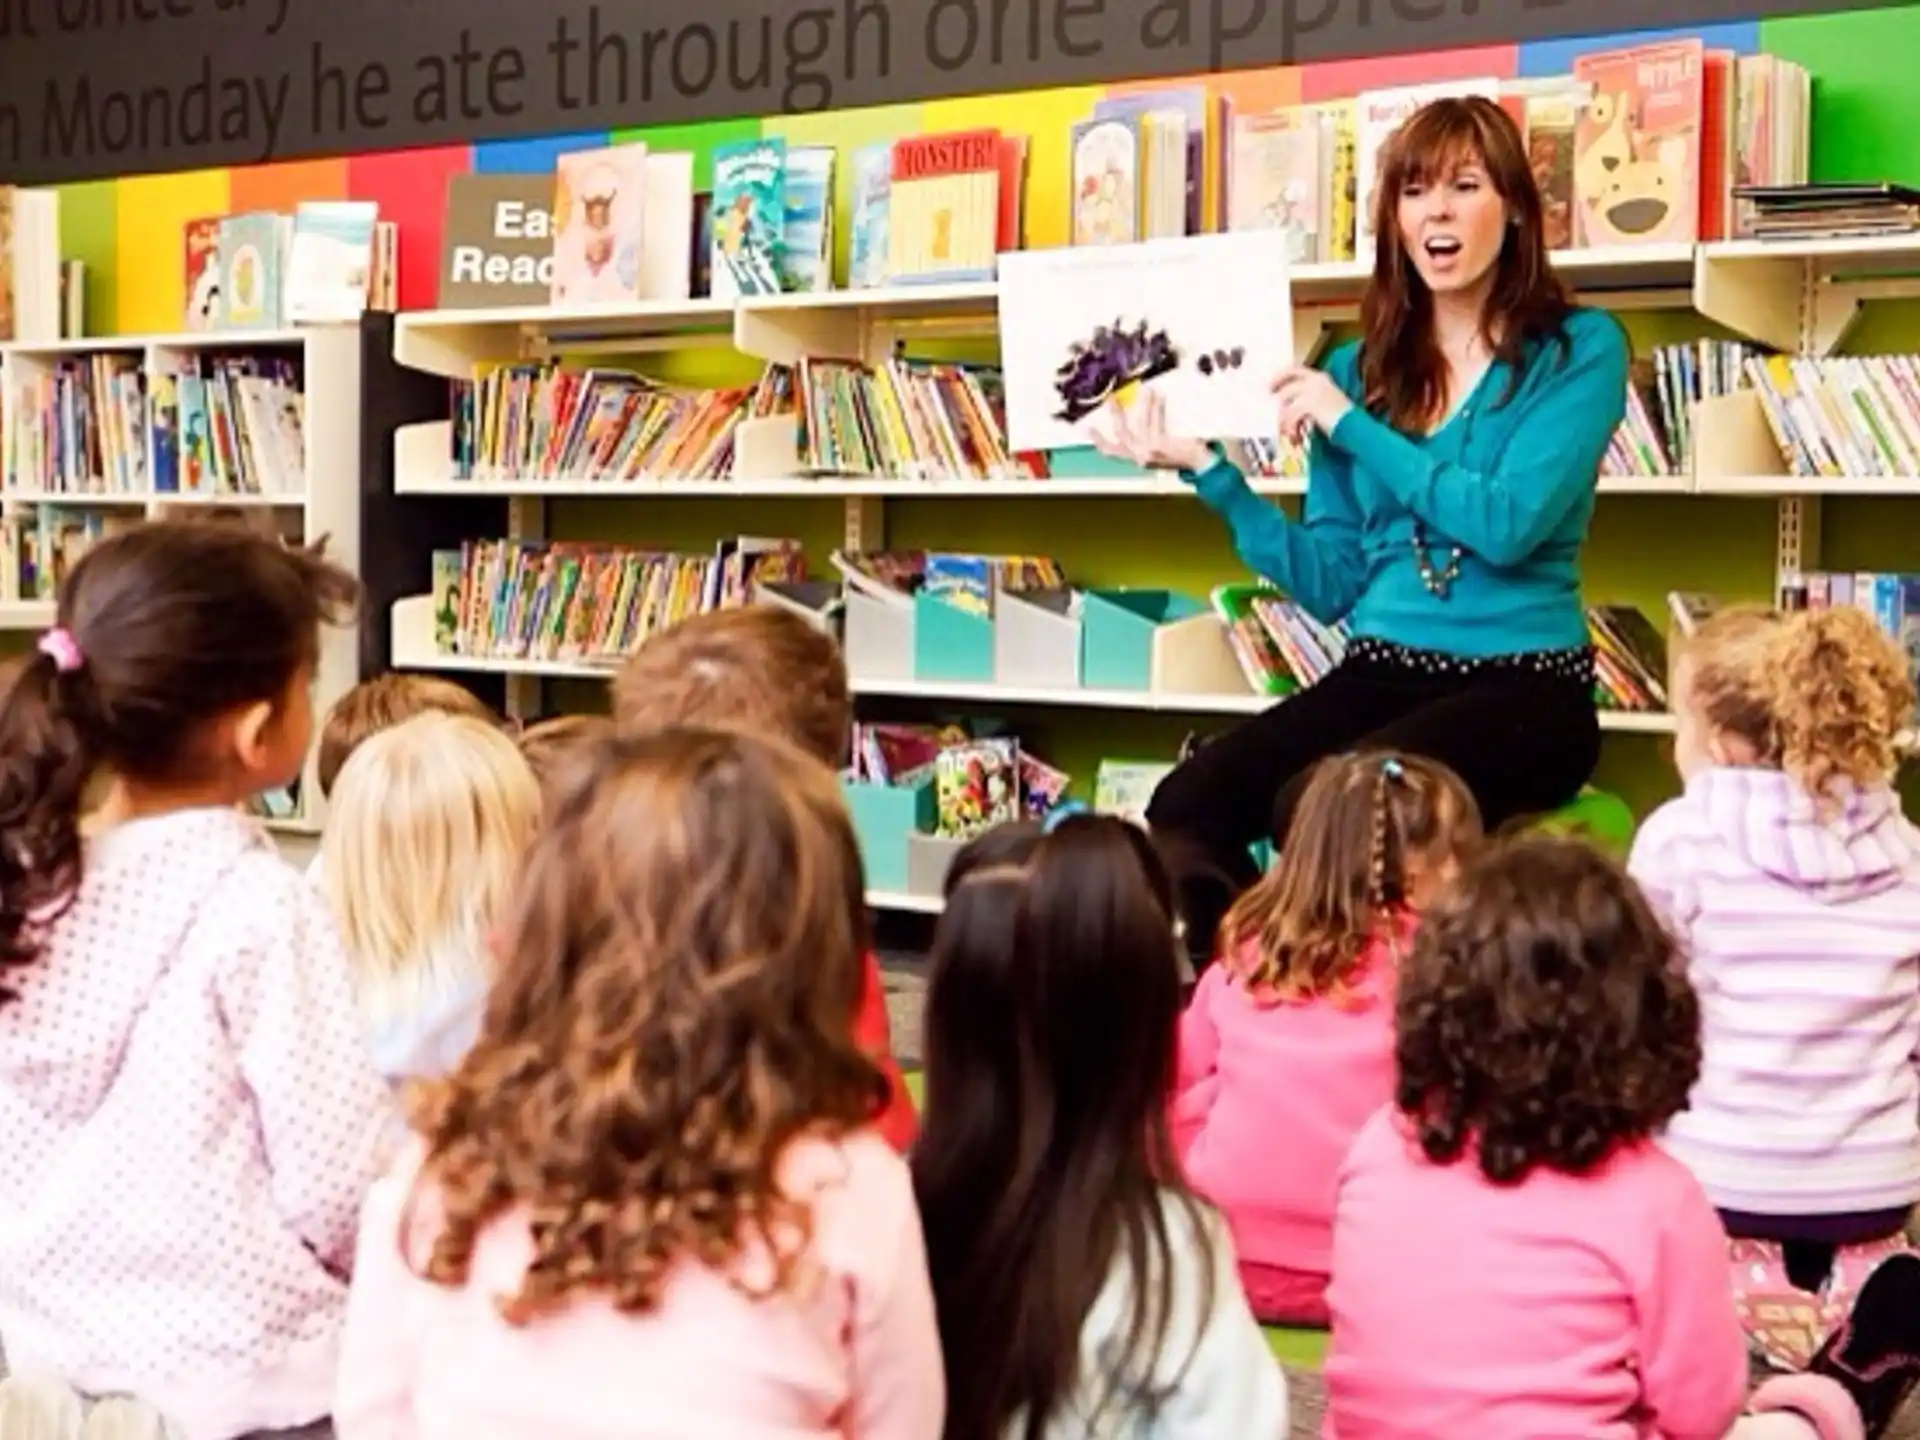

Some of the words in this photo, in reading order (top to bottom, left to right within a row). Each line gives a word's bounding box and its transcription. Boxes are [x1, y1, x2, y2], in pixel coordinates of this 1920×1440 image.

[41, 56, 290, 161] Monday
[312, 41, 390, 133] he
[413, 29, 525, 124] ate
[548, 0, 891, 113] through
[925, 0, 1104, 71] one
[1140, 0, 1480, 73] app.
[494, 201, 556, 238] Ea
